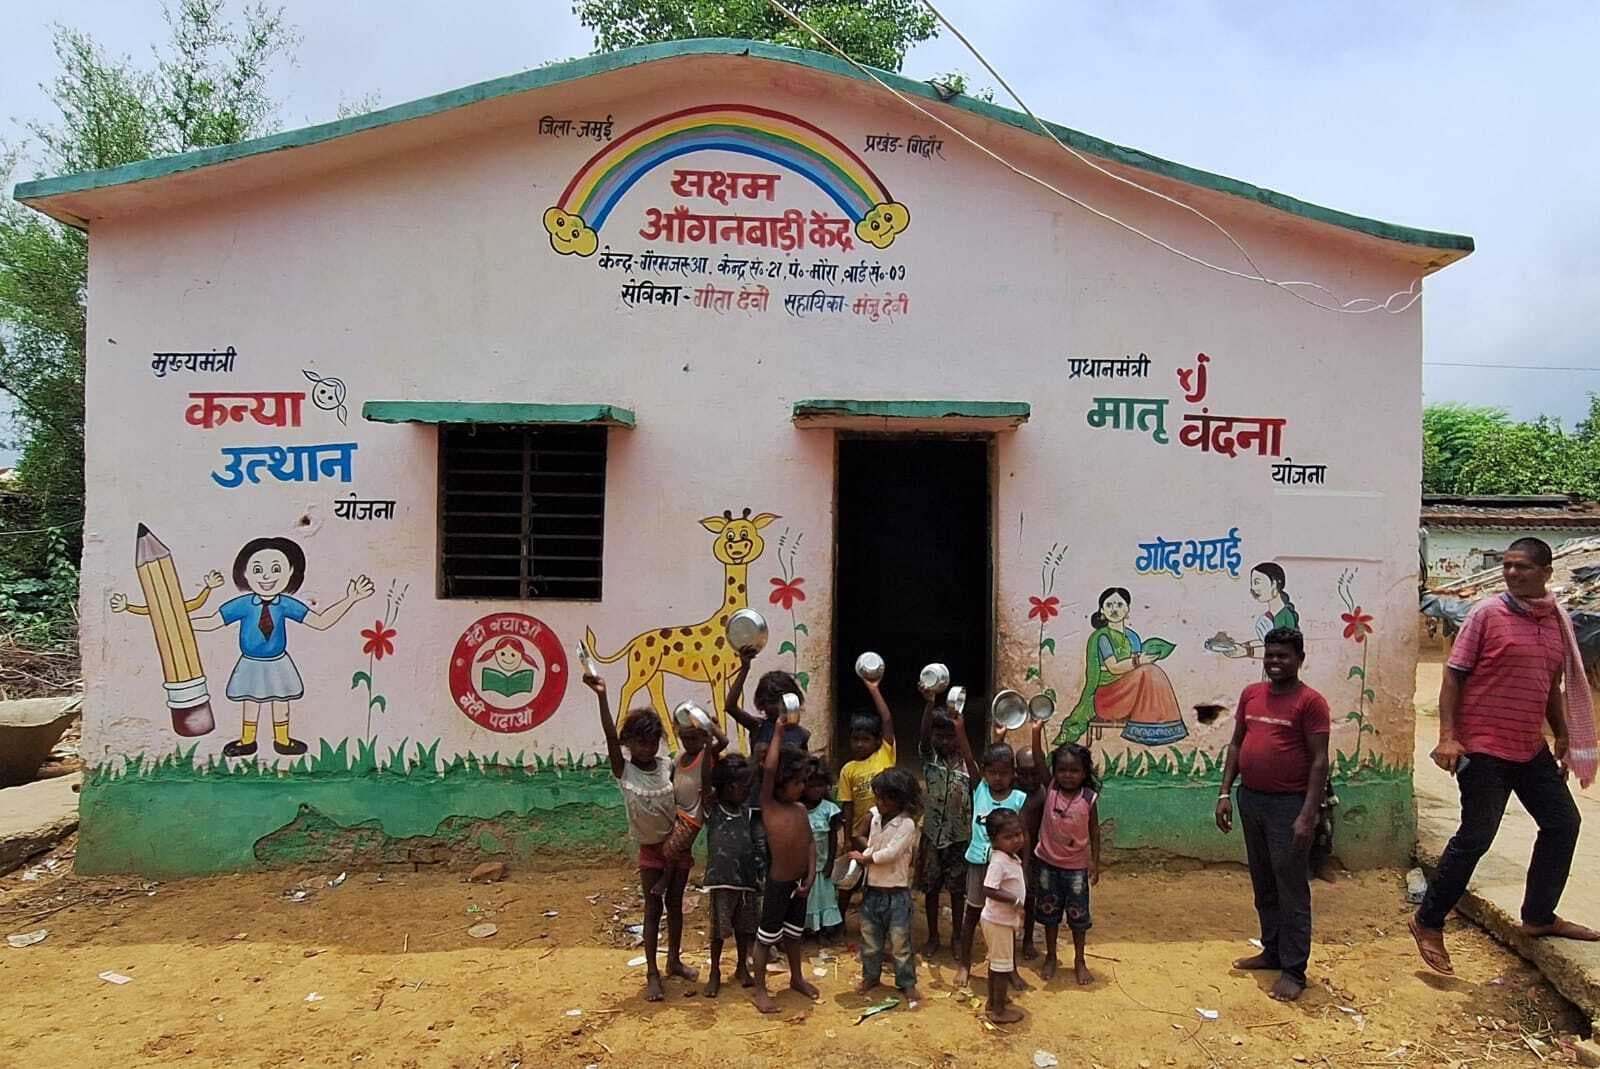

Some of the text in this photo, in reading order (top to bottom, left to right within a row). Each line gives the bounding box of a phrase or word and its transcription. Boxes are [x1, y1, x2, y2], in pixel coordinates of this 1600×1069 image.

[670, 169, 781, 206] सक्षम
[808, 208, 856, 252] केंद्र
[151, 346, 238, 377] मुख्यमंत्री
[1067, 353, 1152, 380] प्रधानमंत्री
[185, 391, 306, 429] कन्या
[1086, 397, 1169, 445] मातृ
[1179, 407, 1287, 459] वंदना
[210, 442, 358, 489] उत्थान
[1271, 456, 1328, 486] योजना
[333, 492, 397, 521] योजना
